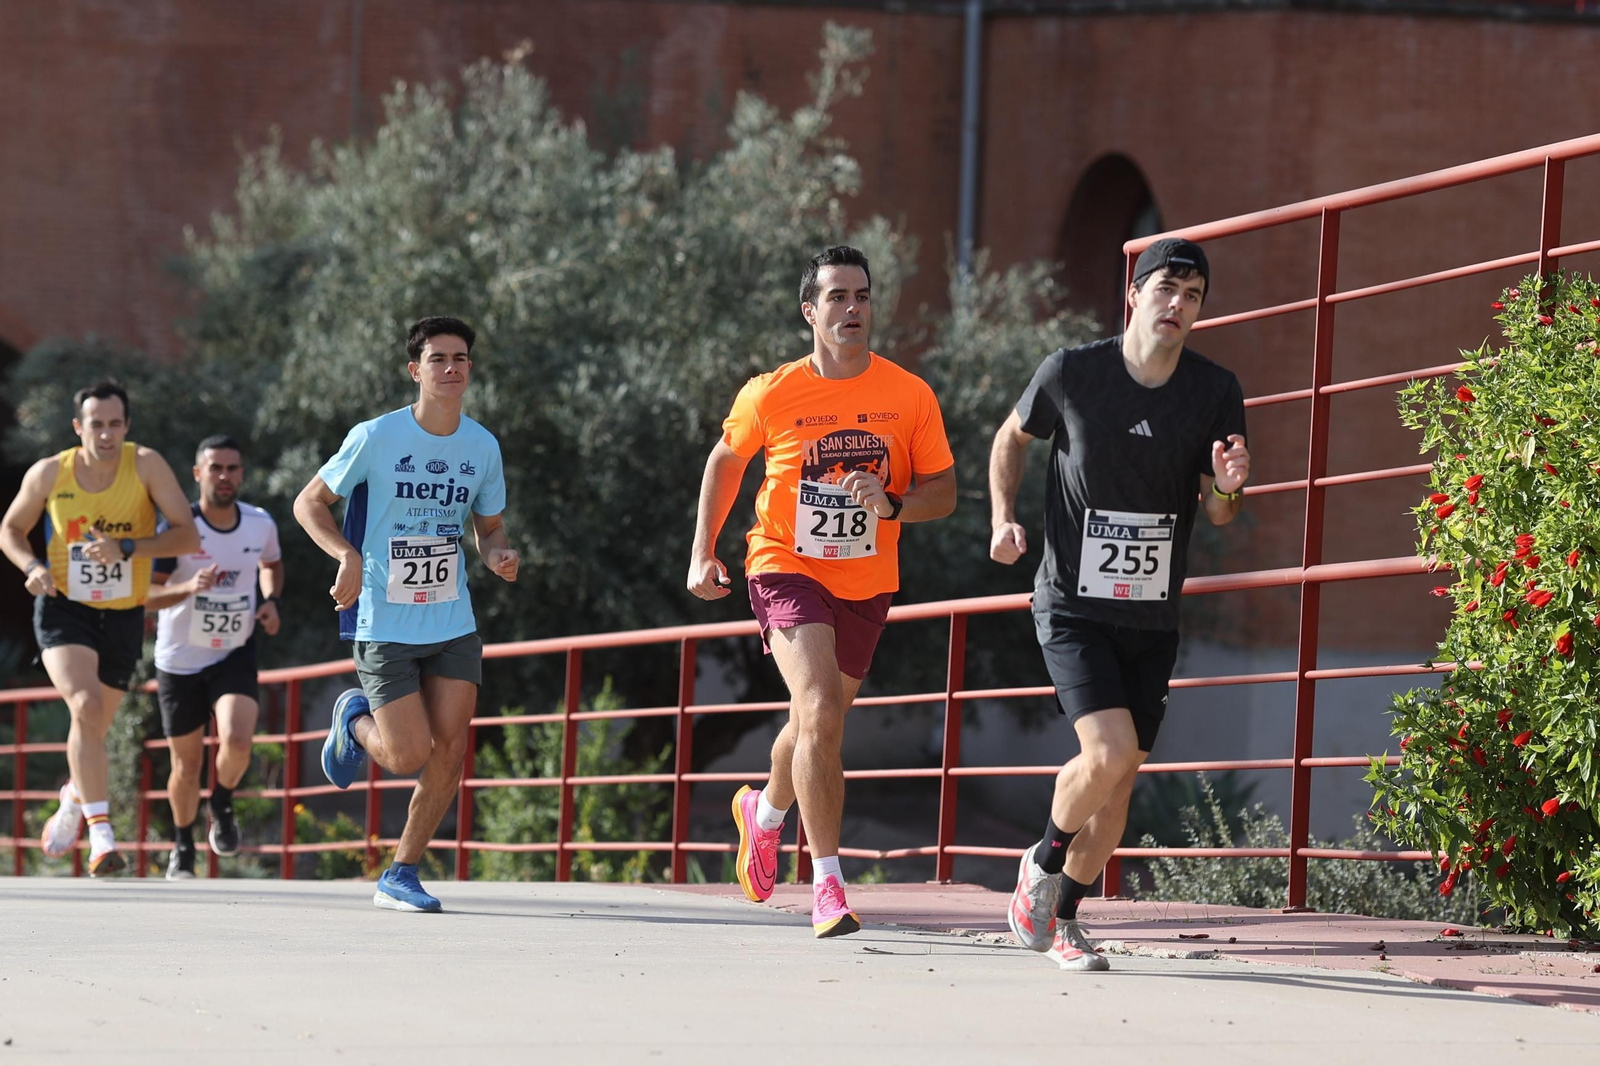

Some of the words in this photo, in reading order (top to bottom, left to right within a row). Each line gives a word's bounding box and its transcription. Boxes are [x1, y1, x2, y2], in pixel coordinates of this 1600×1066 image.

[805, 415, 838, 424] OVIEDO
[869, 412, 900, 420] OVIEDO
[820, 436, 843, 451] SAN
[844, 434, 894, 449] SILVESTRE
[821, 451, 842, 459] CIUDAD
[427, 462, 448, 472] TROPS
[395, 478, 469, 507] nerja
[802, 493, 840, 507] UMA
[406, 507, 457, 518] ATLETISMO
[810, 510, 868, 538] 218
[1090, 524, 1133, 539] UMA
[393, 547, 427, 558] UMA
[1098, 543, 1159, 575] 255
[80, 562, 123, 585] 534
[402, 558, 449, 585] 216
[1114, 587, 1130, 596] WE
[202, 613, 242, 633] 526
